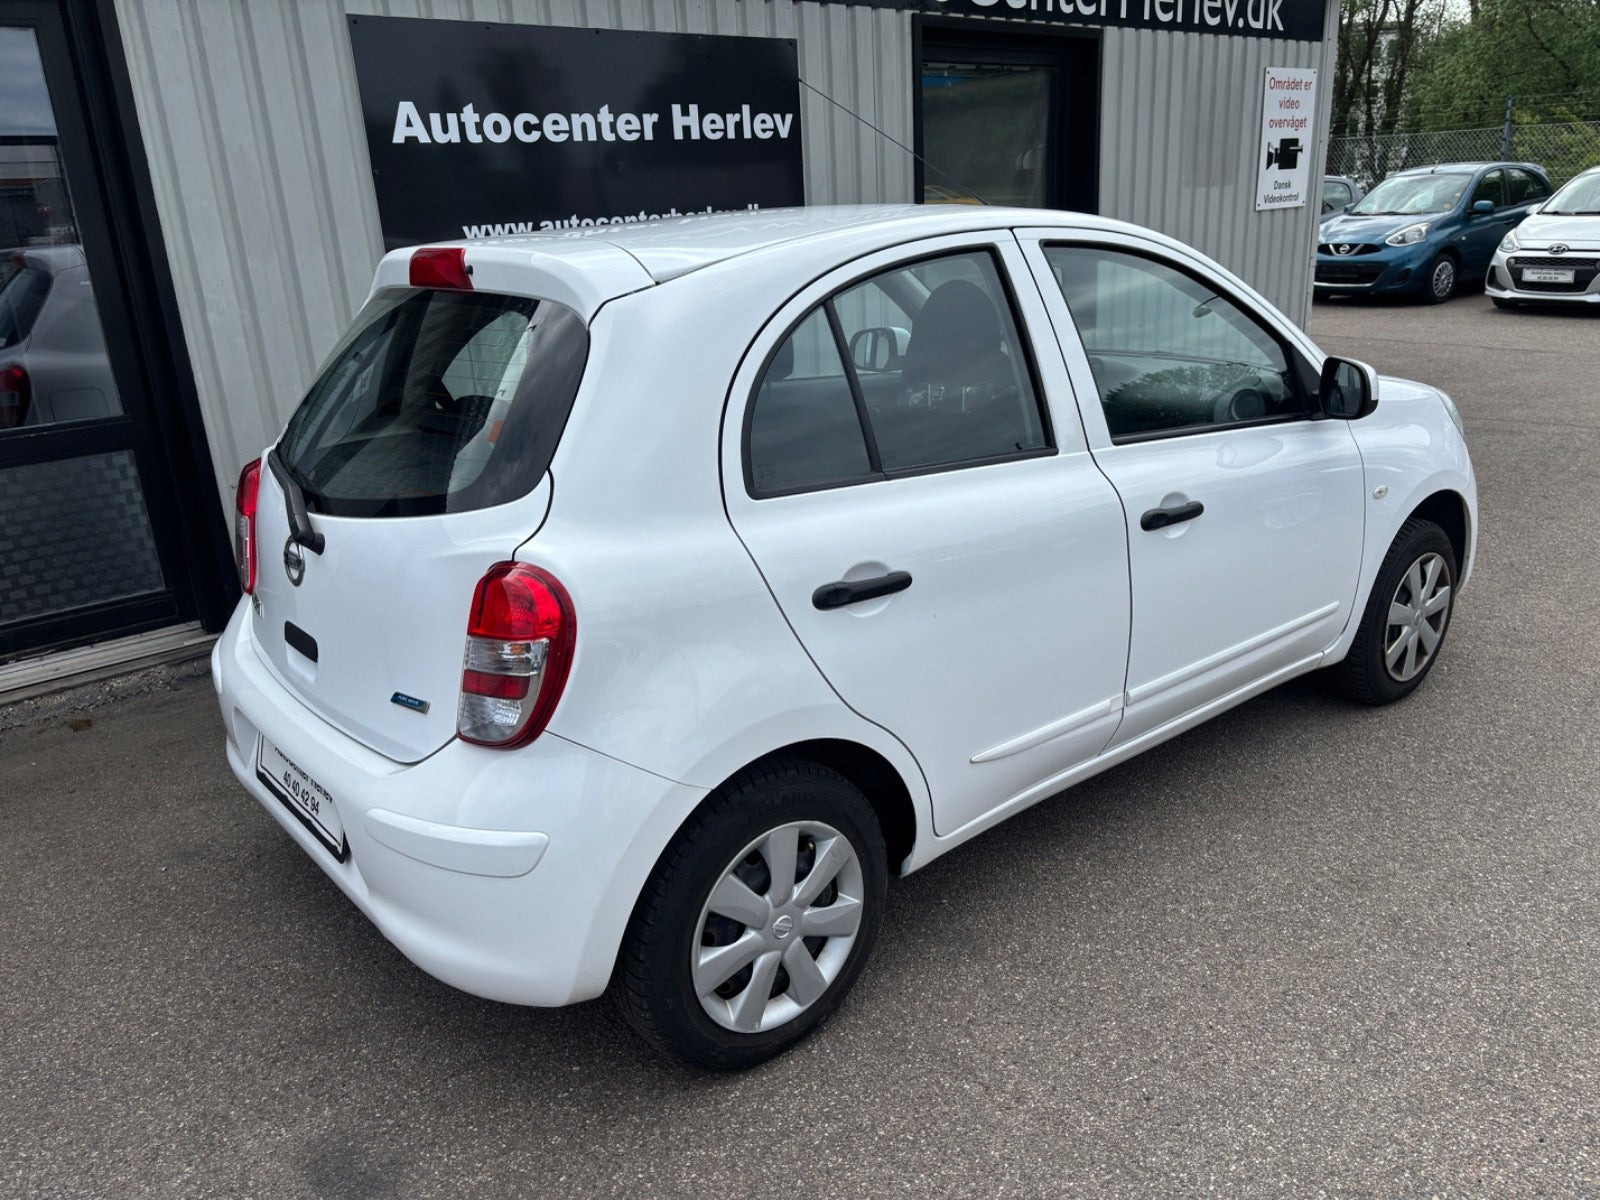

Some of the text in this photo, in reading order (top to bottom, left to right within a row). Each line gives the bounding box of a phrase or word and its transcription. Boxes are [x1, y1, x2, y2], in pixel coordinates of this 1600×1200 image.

[1269, 77, 1312, 91] Området er
[1279, 97, 1300, 109] video
[392, 101, 793, 144] Autocenter Herlev
[1269, 115, 1307, 131] overvåget
[1274, 180, 1291, 190] Dansk
[1264, 193, 1299, 204] Videokontrol
[283, 770, 292, 788] 40
[291, 781, 300, 797] 40
[300, 788, 310, 807] 42
[310, 796, 320, 815] 94
